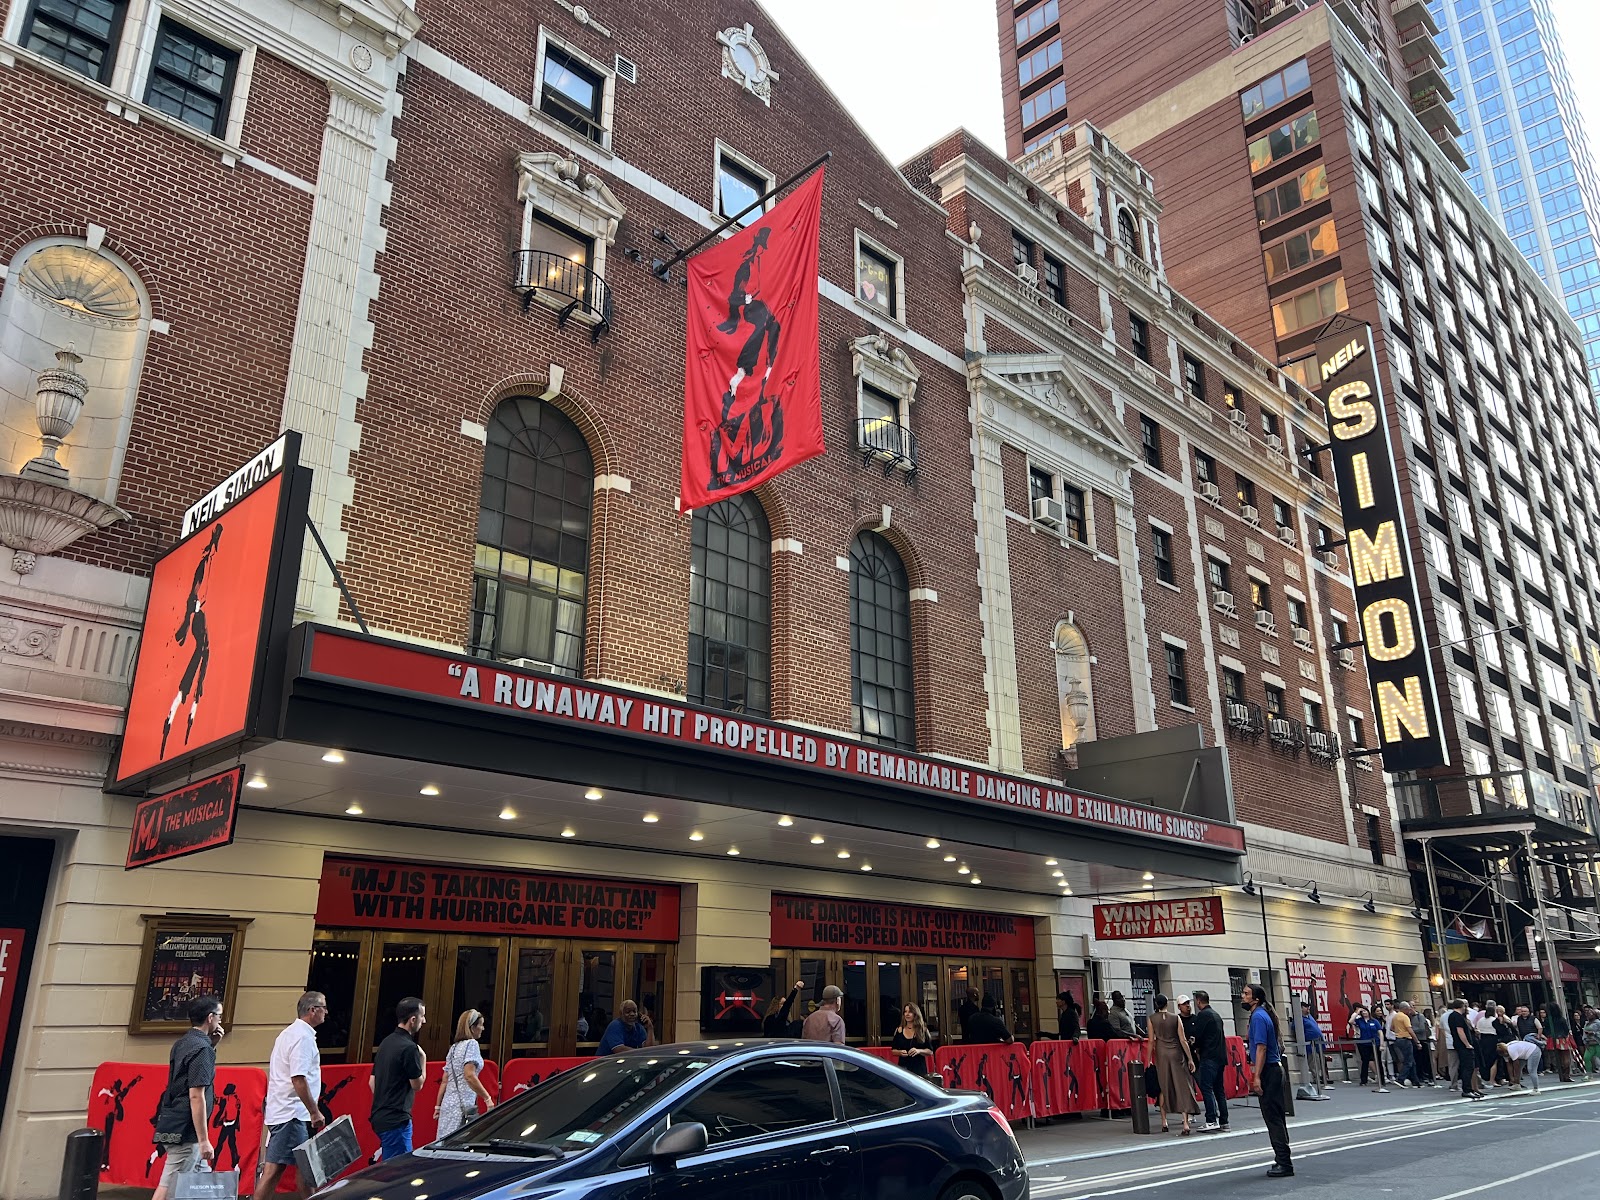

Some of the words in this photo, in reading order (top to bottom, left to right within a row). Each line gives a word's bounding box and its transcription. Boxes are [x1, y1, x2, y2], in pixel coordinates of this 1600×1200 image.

[1321, 339, 1365, 381] NEIL
[717, 473, 731, 486] THE
[733, 455, 774, 482] MUSICAL
[188, 493, 219, 533] NEIL
[224, 448, 276, 504] SIMON
[1328, 380, 1431, 743] SIMON
[448, 663, 480, 698] “A
[493, 672, 633, 727] RUNAWAY
[642, 702, 685, 736] HIT
[694, 713, 817, 763] PROPELLED
[825, 741, 850, 769] BY
[856, 749, 970, 794] REMARKABLE
[976, 774, 1041, 809] DANCING
[1046, 790, 1073, 815] AND
[1077, 797, 1163, 833] EXHILARATING
[1166, 815, 1208, 841] SONGS!”
[135, 806, 165, 854] MJ
[165, 812, 182, 833] THE
[182, 798, 224, 828] MUSICAL
[338, 866, 396, 893] “MJ
[401, 871, 425, 895] IS
[431, 873, 521, 901] TAKING
[525, 880, 657, 910] MANHATTAN
[352, 893, 424, 920] WITH
[429, 896, 569, 928] HURRICANE
[571, 906, 652, 931] FORCE!”
[776, 899, 815, 921] “THE
[818, 904, 881, 926] DANCING
[884, 908, 898, 927] IS
[900, 909, 960, 931] FLAT-OUT
[961, 914, 1017, 937] AMAZING,
[1100, 900, 1211, 923] WINNER!
[1102, 923, 1111, 937] 4
[1113, 920, 1150, 936] TONY
[1153, 917, 1215, 934] AWARDS
[812, 923, 898, 947] HIGH-SPEED
[901, 929, 928, 948] AND
[930, 931, 996, 951] ELECTRIC!”
[1449, 973, 1480, 981] RUSSIAN
[1480, 973, 1517, 981] SAMOVAR
[153, 1132, 183, 1144] BOSS
